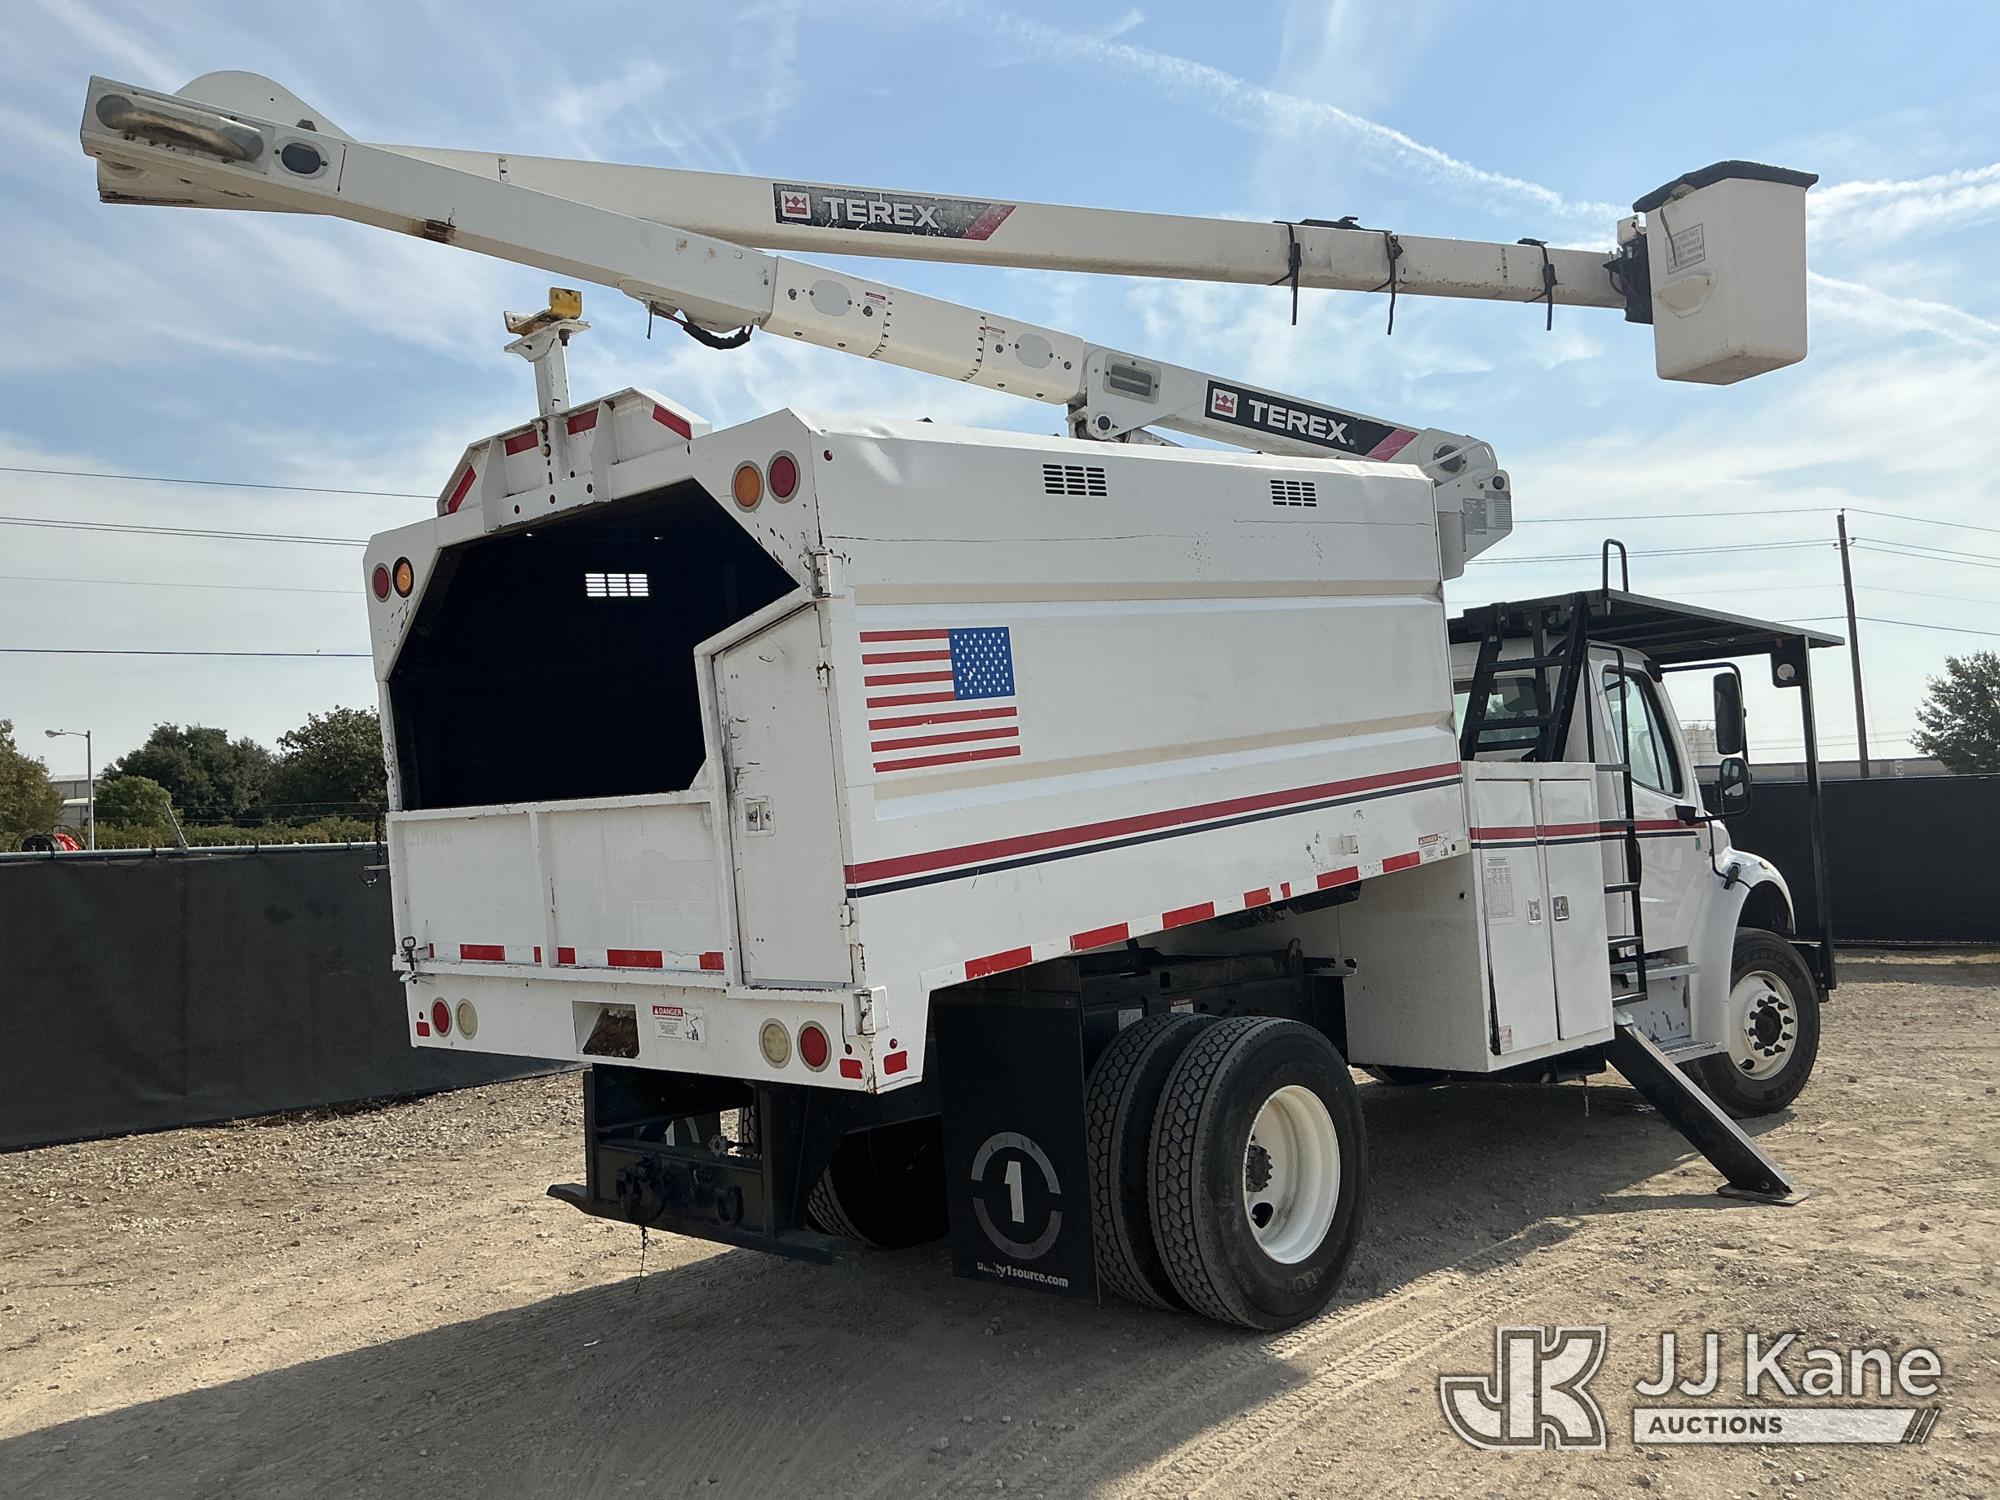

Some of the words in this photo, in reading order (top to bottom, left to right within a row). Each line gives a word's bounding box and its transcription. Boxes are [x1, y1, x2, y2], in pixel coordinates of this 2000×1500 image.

[822, 196, 940, 229] TEREX
[1248, 398, 1348, 445] TEREX
[658, 1007, 682, 1016] DANGER
[1004, 1160, 1025, 1223] 1
[977, 1261, 1069, 1288] uty1source.com
